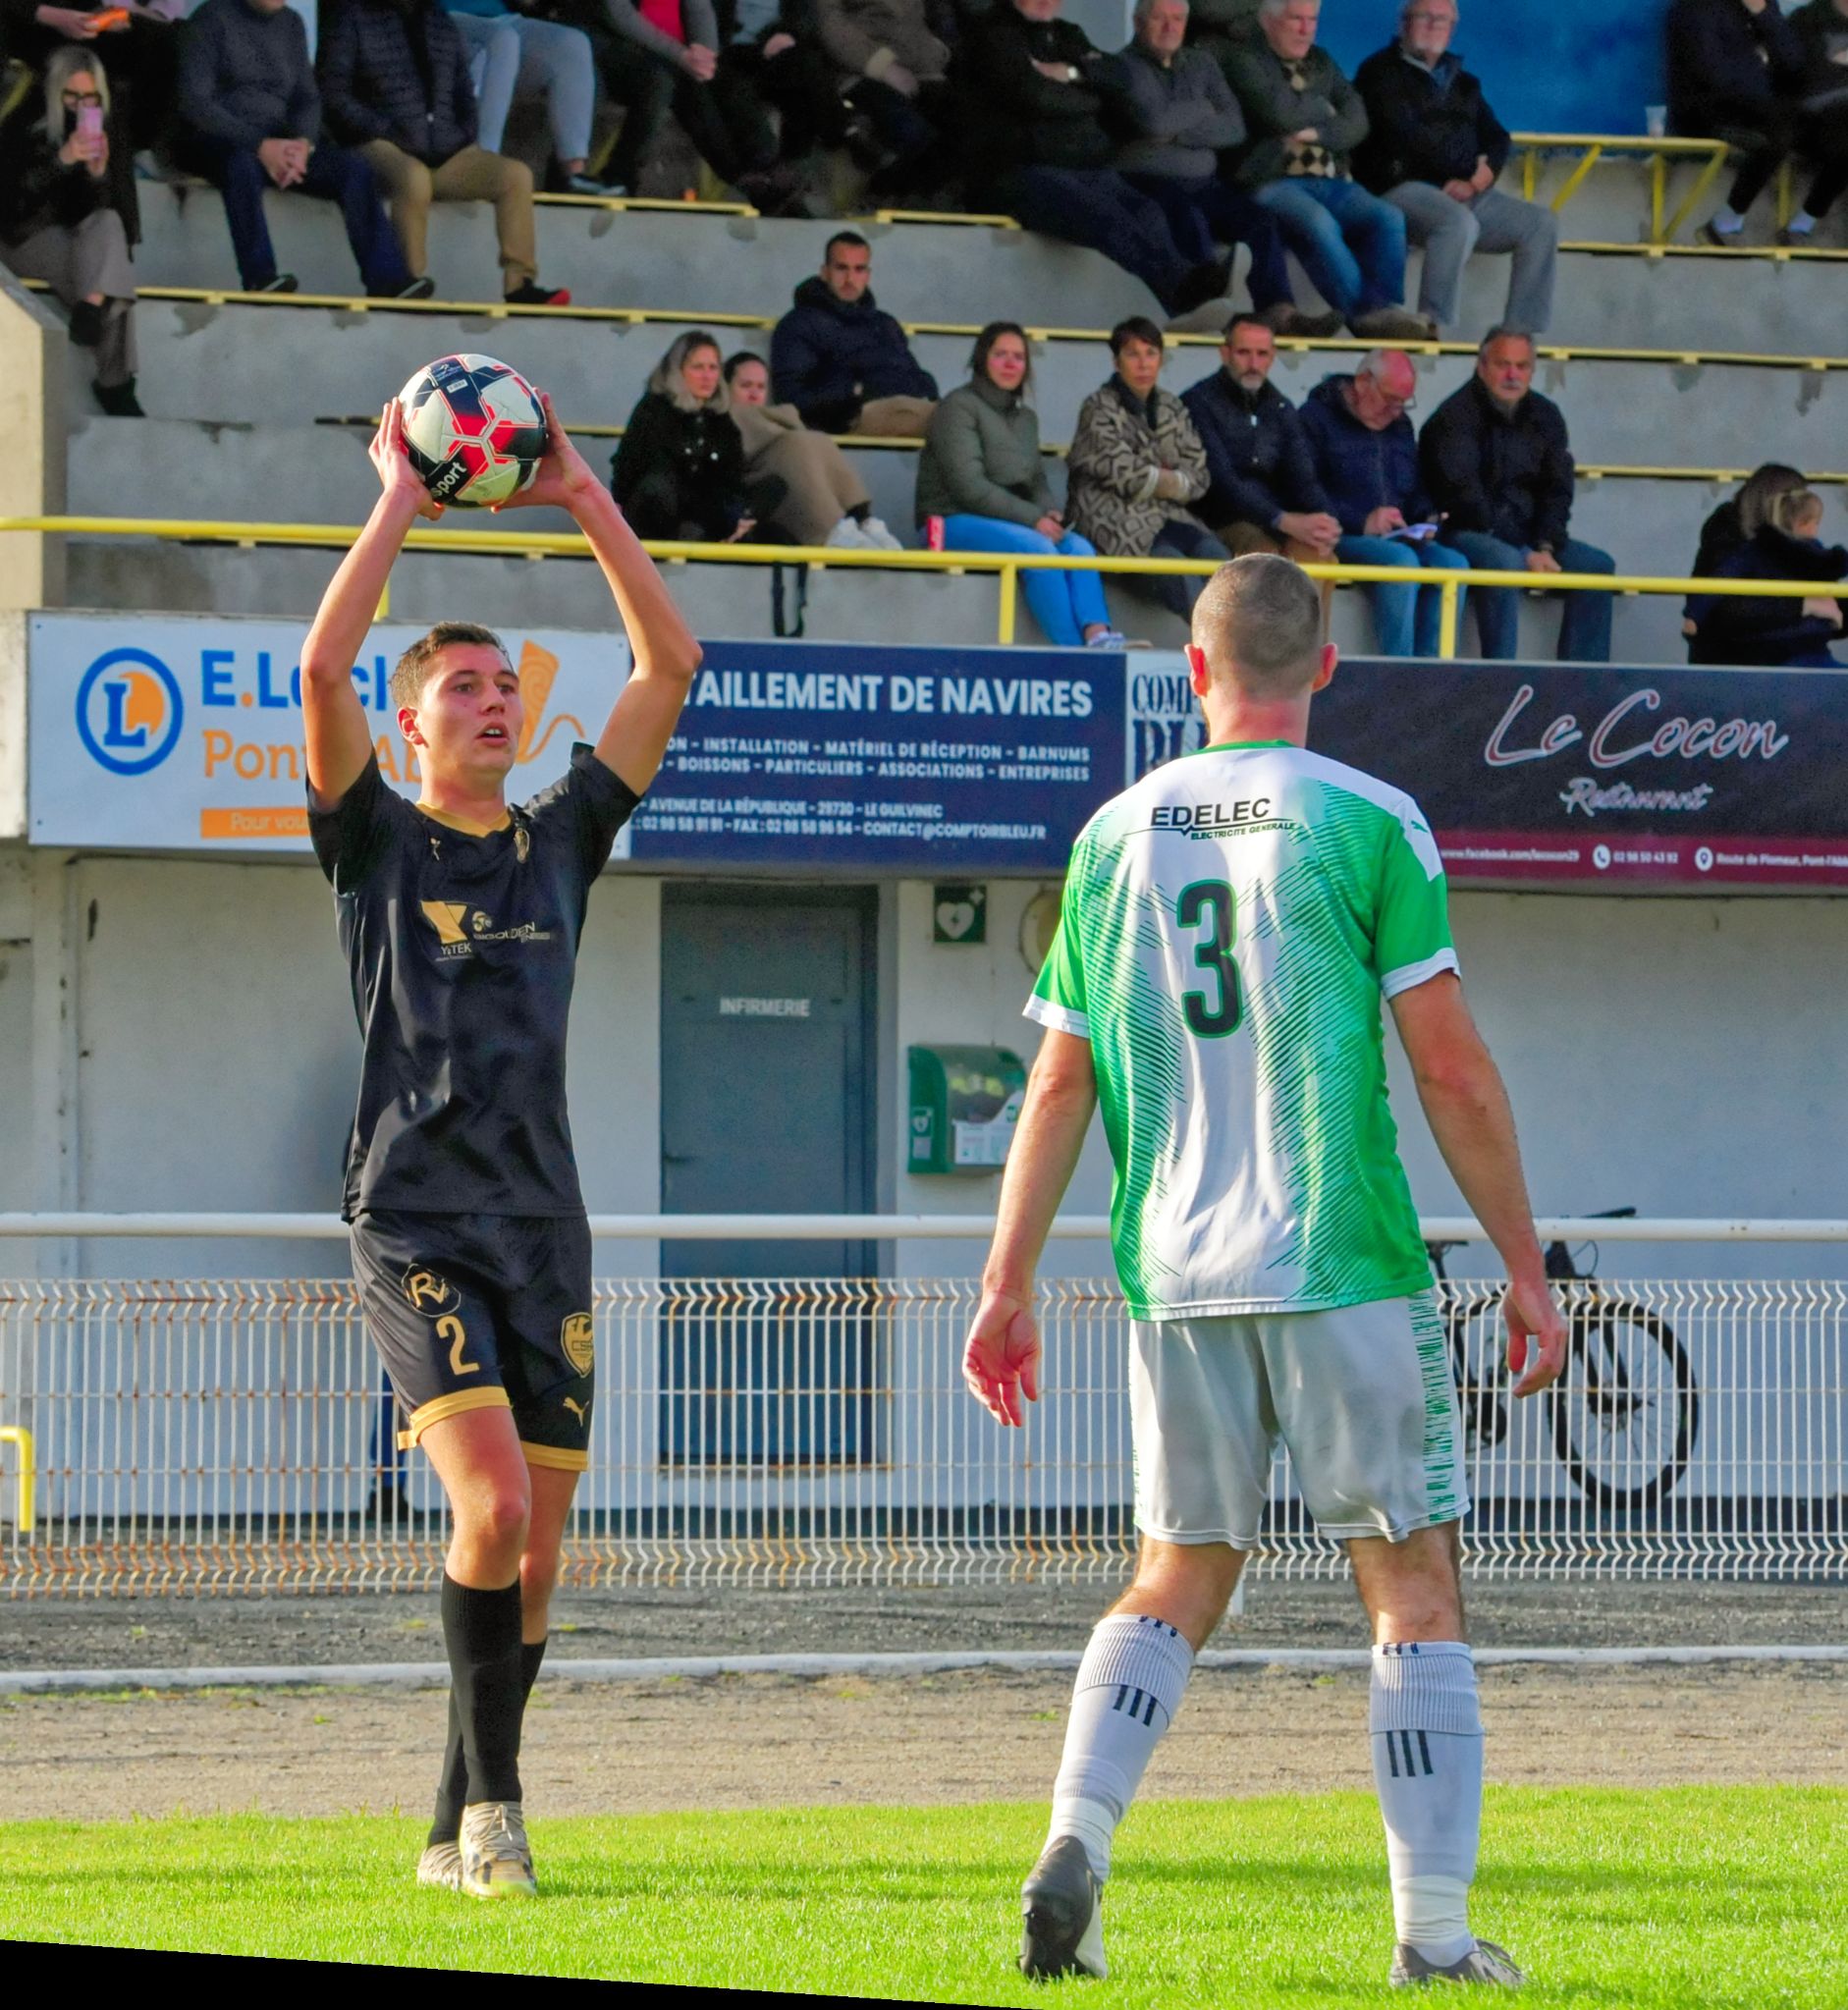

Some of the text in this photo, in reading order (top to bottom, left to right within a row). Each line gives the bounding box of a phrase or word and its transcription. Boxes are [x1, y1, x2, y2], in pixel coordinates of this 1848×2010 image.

[890, 675, 935, 713] DE
[941, 678, 1093, 717] NAVIRES
[1484, 684, 1789, 768] Le Cocon
[702, 737, 810, 755] INSTALLATION
[825, 738, 895, 757] MATÉRIEL
[897, 742, 917, 758] DE
[920, 739, 1003, 760] RÉCEPTION
[1017, 746, 1090, 762] BARNUMS
[677, 756, 751, 773] BOISSONS
[764, 758, 864, 776] PARTICULIERS
[878, 762, 985, 780] ASSOCIATIONS
[998, 765, 1090, 781] ENTREPRISES
[649, 797, 698, 813] AVENUE
[699, 798, 716, 813] DE
[717, 799, 734, 813] LA
[734, 796, 807, 816] RÉPUBLIQUE
[864, 802, 877, 817] LE
[1150, 798, 1272, 827] EDELEC
[230, 811, 307, 832] Pour vou
[1190, 823, 1297, 841] ELECTRICITE GENERALE
[1176, 879, 1243, 1039] 3
[719, 997, 811, 1017] INFIRMERIE
[435, 1315, 481, 1376] 2
